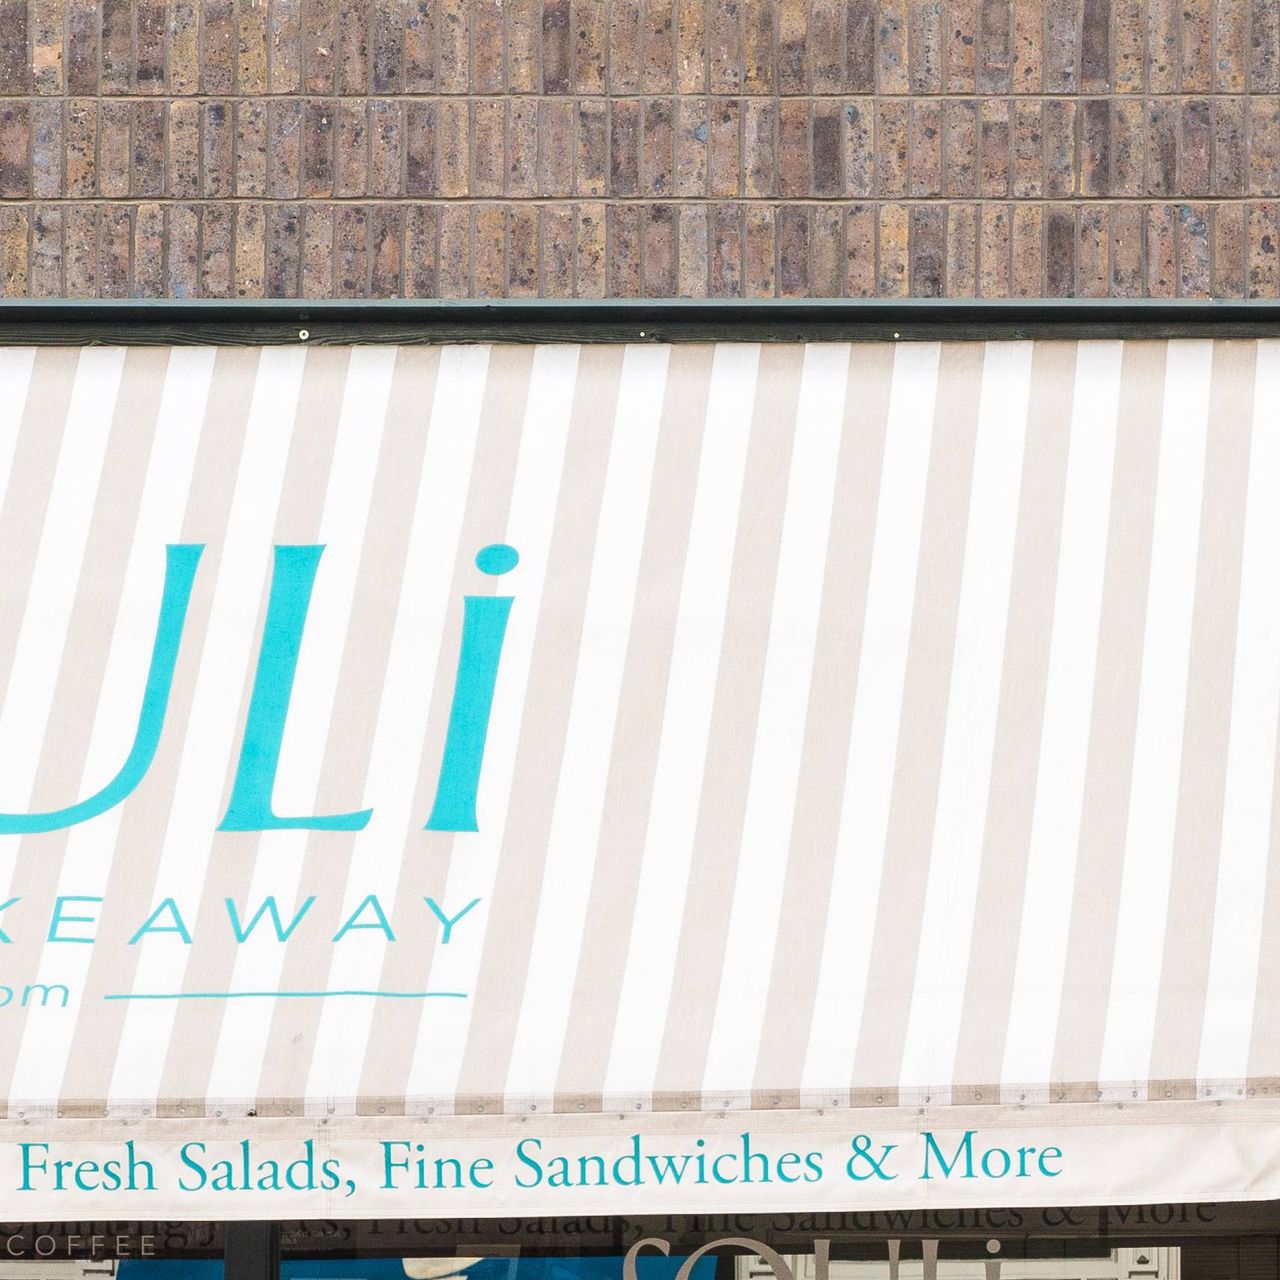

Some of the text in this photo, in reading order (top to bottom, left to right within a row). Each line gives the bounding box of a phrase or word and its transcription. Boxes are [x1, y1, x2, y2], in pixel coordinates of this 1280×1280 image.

[16, 1130, 1064, 1198] Fresh Salads, Fine Sandwiches & More
[6, 1234, 156, 1257] COFFEE
